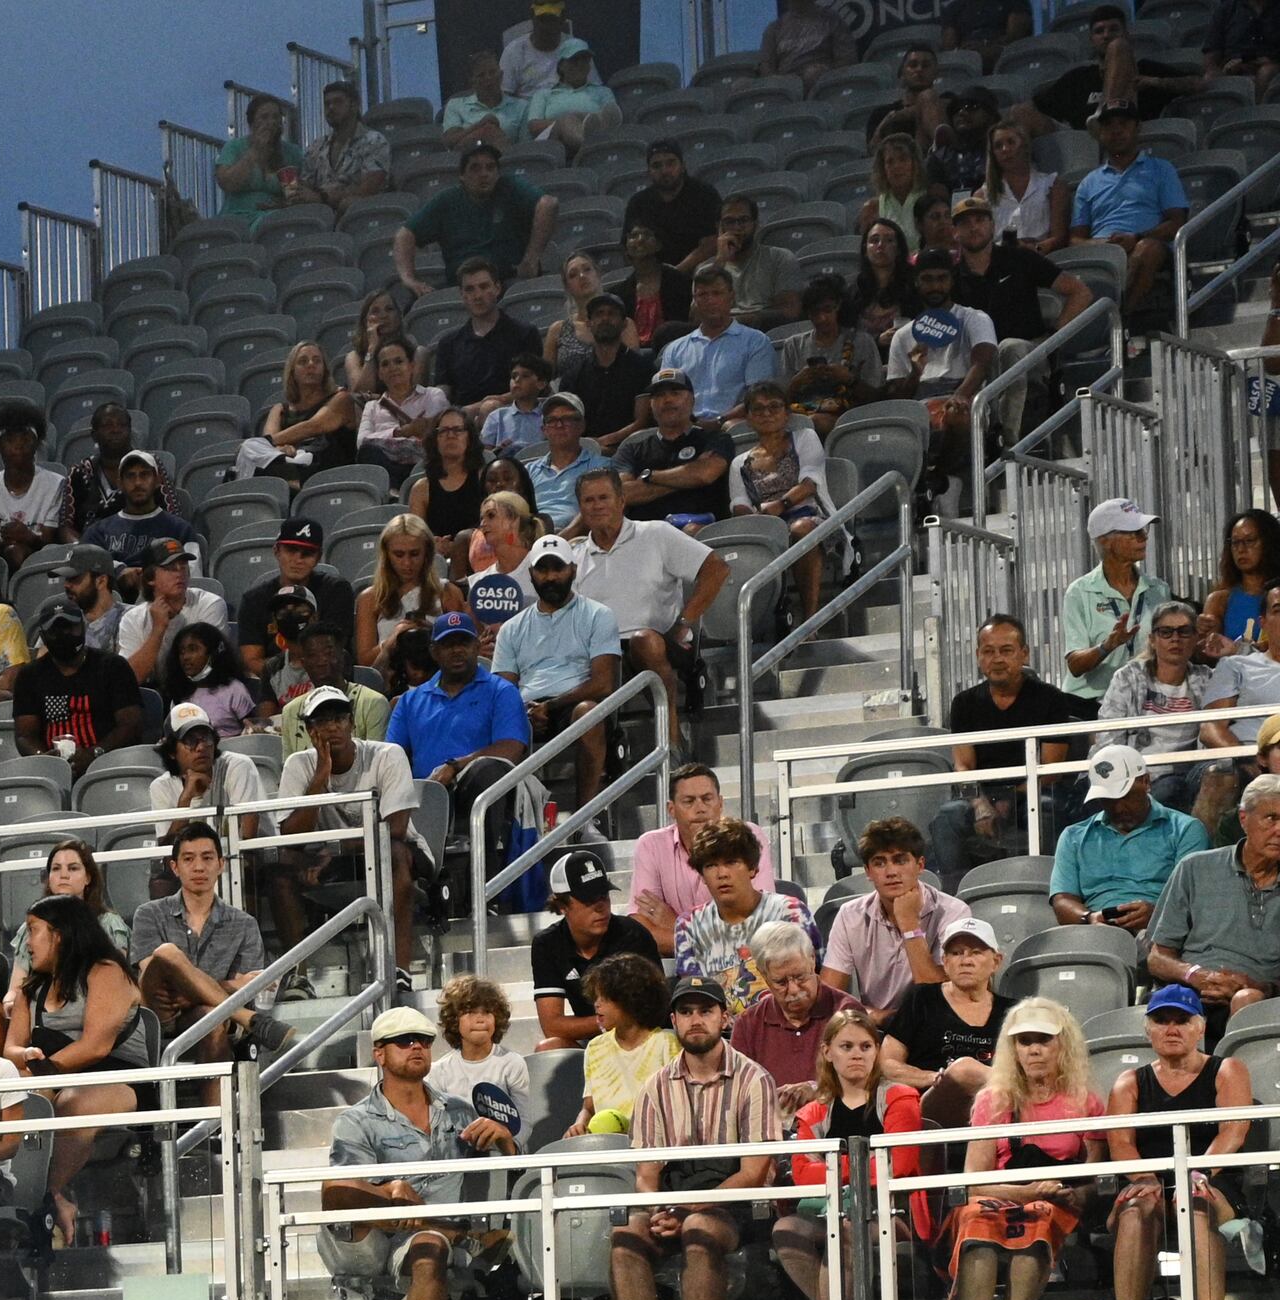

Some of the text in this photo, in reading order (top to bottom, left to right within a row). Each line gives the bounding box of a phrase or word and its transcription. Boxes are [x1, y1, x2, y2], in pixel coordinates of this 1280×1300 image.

[880, 0, 944, 26] NC
[919, 315, 958, 336] Atlanta
[476, 587, 503, 598] GAS
[476, 599, 519, 611] SOUTH
[943, 1030, 992, 1045] Grandmas
[476, 1092, 518, 1118] Atlanta
